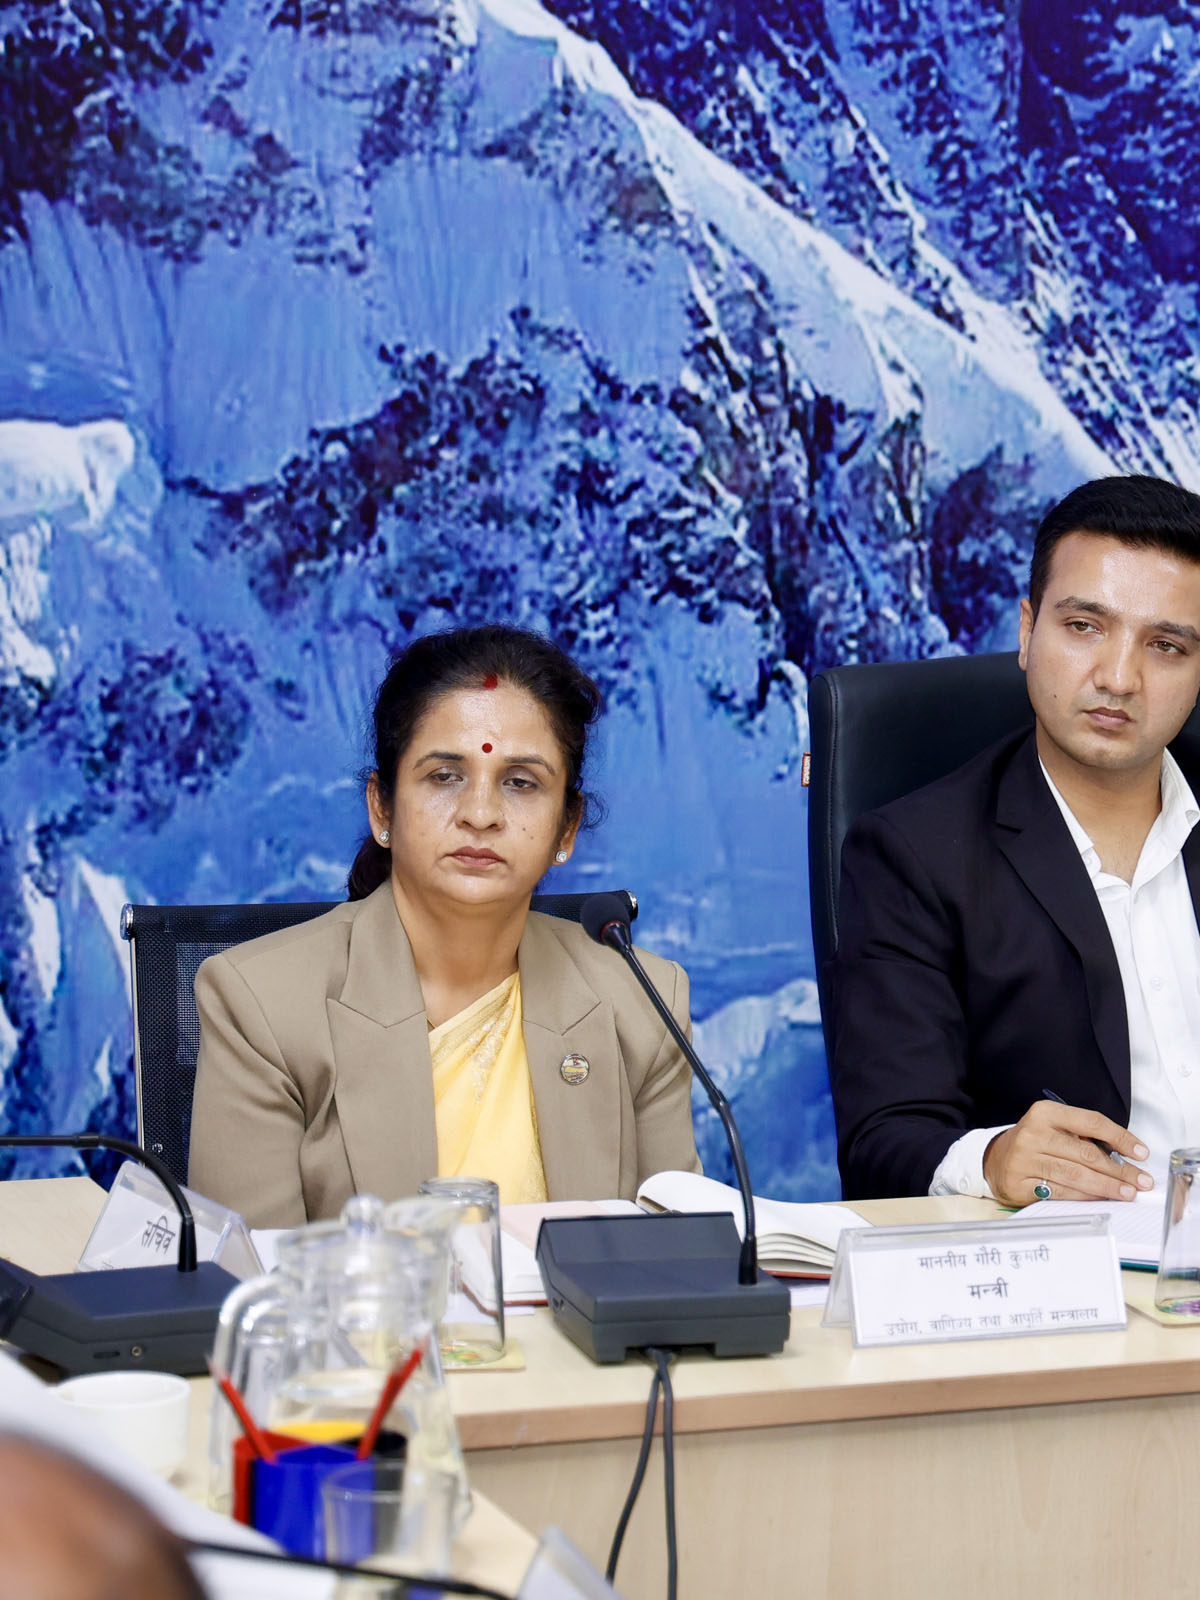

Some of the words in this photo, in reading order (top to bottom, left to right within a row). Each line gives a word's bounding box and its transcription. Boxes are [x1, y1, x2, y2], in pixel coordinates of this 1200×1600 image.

[140, 1215, 176, 1255] सचिव
[918, 1250, 968, 1269] माननीय
[973, 1246, 1002, 1265] गौरी
[966, 1276, 1009, 1300] मन्त्री
[927, 1314, 972, 1331] वाणिज्य
[979, 1315, 1002, 1328] तथा
[1049, 1307, 1099, 1324] मन्त्रालय
